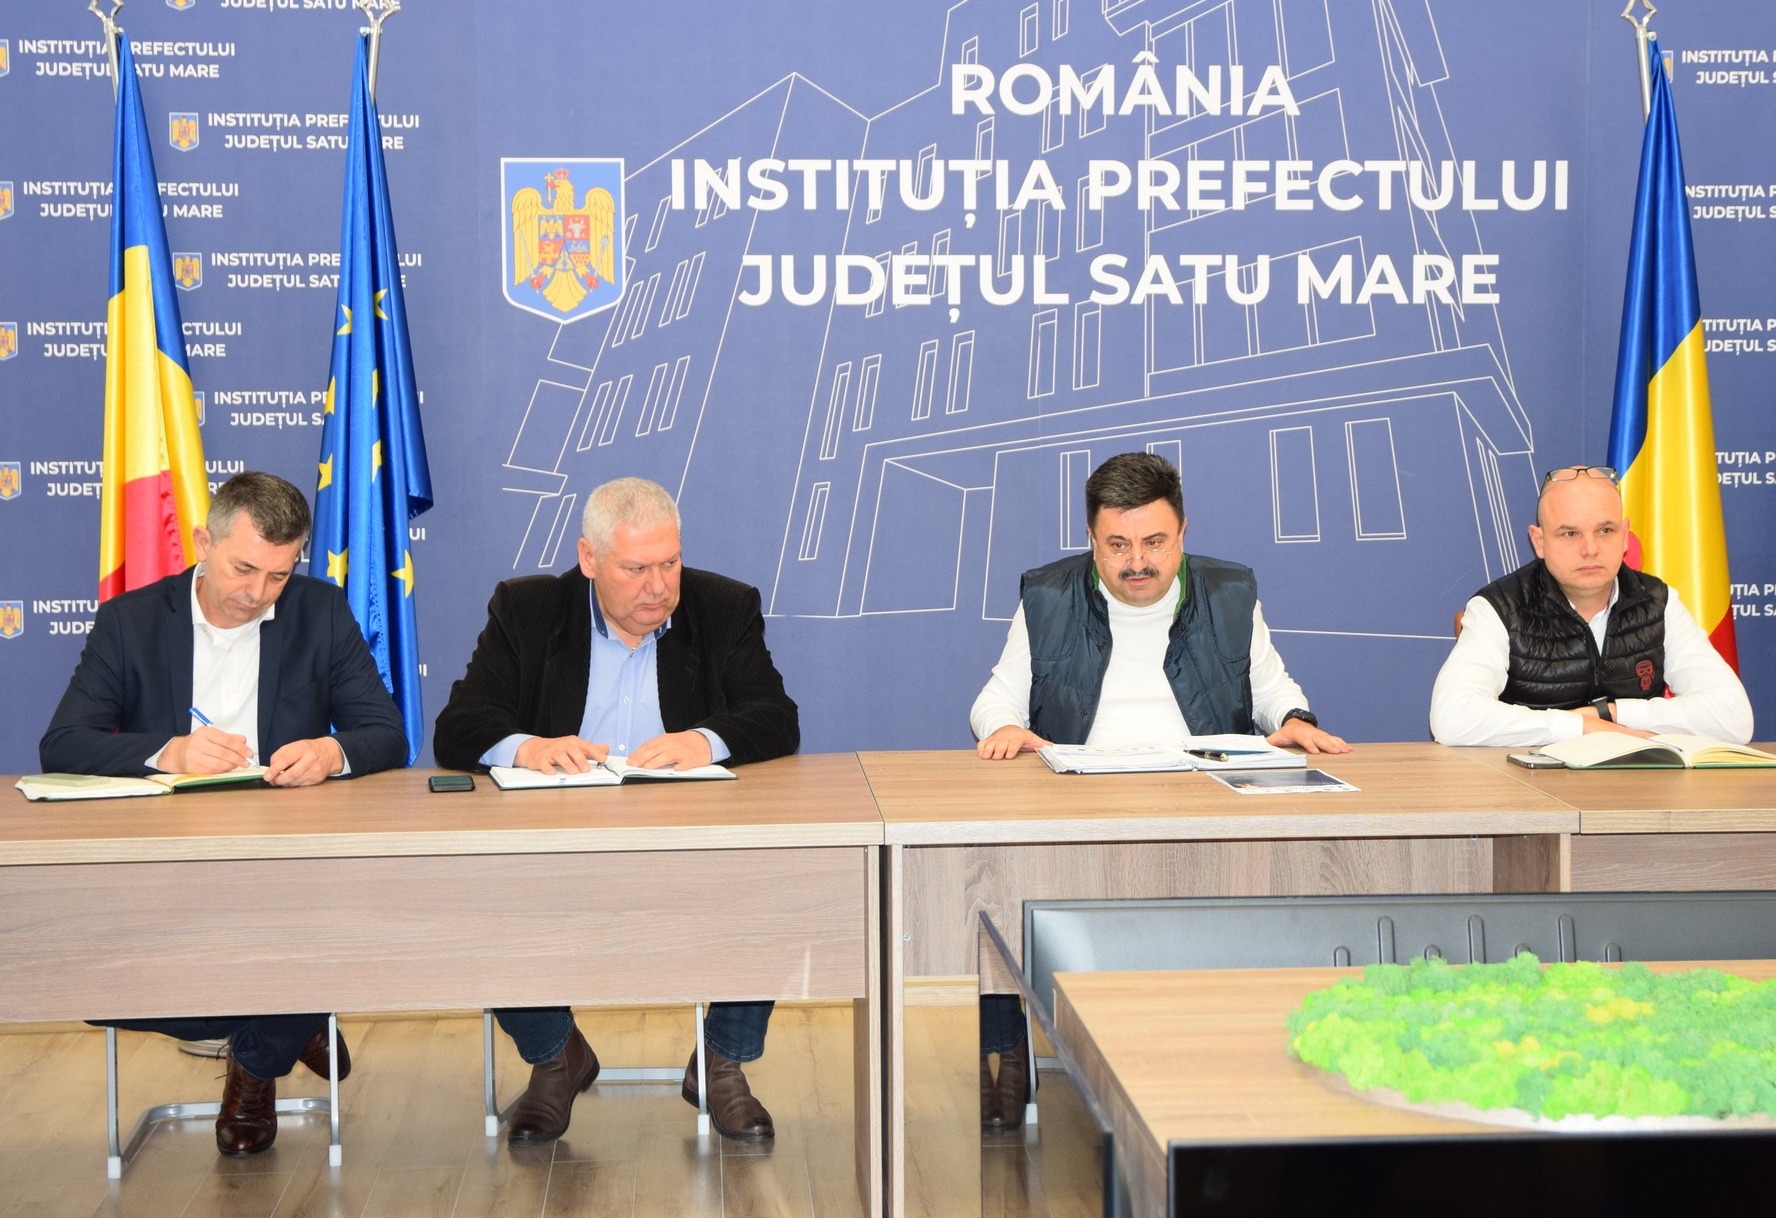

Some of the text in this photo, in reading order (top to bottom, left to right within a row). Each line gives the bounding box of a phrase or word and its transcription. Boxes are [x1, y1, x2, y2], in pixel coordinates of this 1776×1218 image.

[131, 42, 235, 56] REFECTULUI
[1681, 50, 1769, 67] INSTITUȚIA
[170, 64, 220, 77] MARE
[951, 50, 1300, 116] ROMÂNIA
[1695, 71, 1769, 88] JUDEȚUL
[208, 113, 420, 131] INSTITUȚIA PREFULUI
[225, 135, 303, 152] JUDEȚUL
[306, 136, 348, 149] SATU
[157, 182, 239, 196] FECTULUI
[671, 158, 1568, 228] INSTITUȚIA PREFECTULUI
[1684, 185, 1766, 201] NSTITUȚIA
[173, 204, 223, 217] MARE
[1693, 206, 1766, 222] JUDEȚUL
[212, 252, 304, 269] INSTITUȚIA
[228, 275, 340, 291] JUDEȚUL SAT
[738, 254, 1500, 323] JUDEȚUL SATU MARE
[27, 322, 241, 339] INSTITUȚI CTULUI
[1702, 319, 1763, 334] TITUȚIA
[214, 391, 307, 408] INSTITUȚIA
[230, 412, 307, 429] JUDEȚUL
[30, 461, 103, 478] INSTITUȚ
[47, 482, 103, 499] JUDEȚ
[33, 600, 99, 613] INSTITU
[49, 621, 95, 634] JUDE
